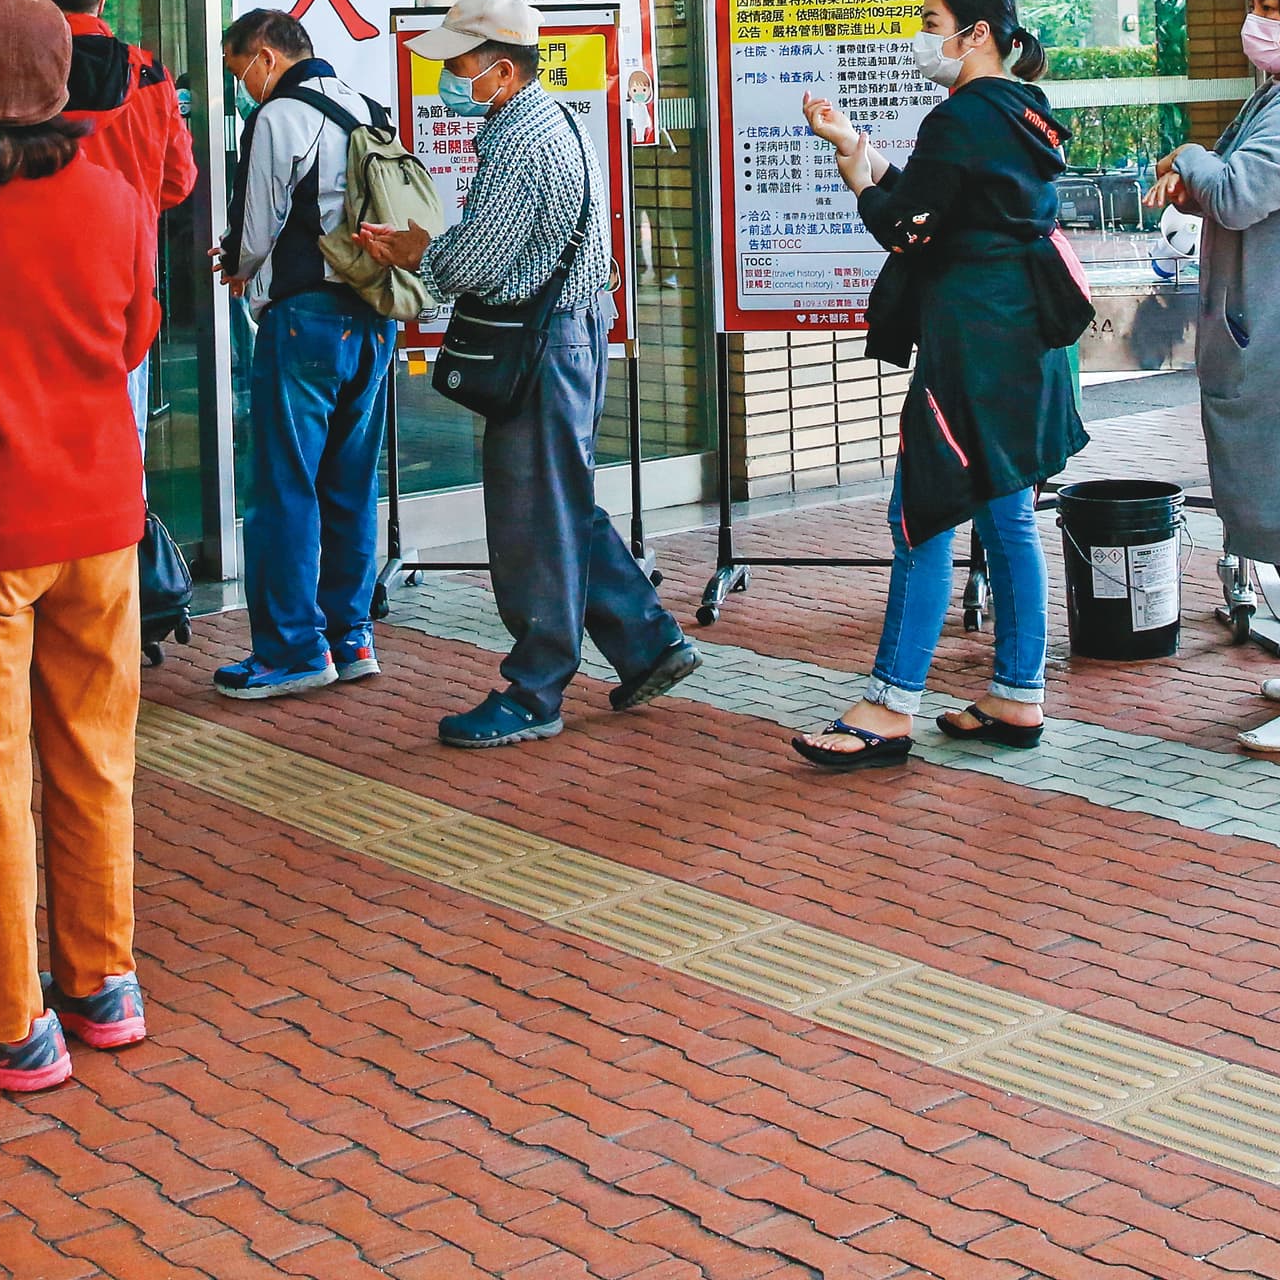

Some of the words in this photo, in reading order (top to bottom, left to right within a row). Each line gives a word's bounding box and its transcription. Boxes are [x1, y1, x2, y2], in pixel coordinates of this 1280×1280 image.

[837, 43, 913, 54] 攜帶健保卡(身分
[749, 238, 802, 250] 告知TOCC
